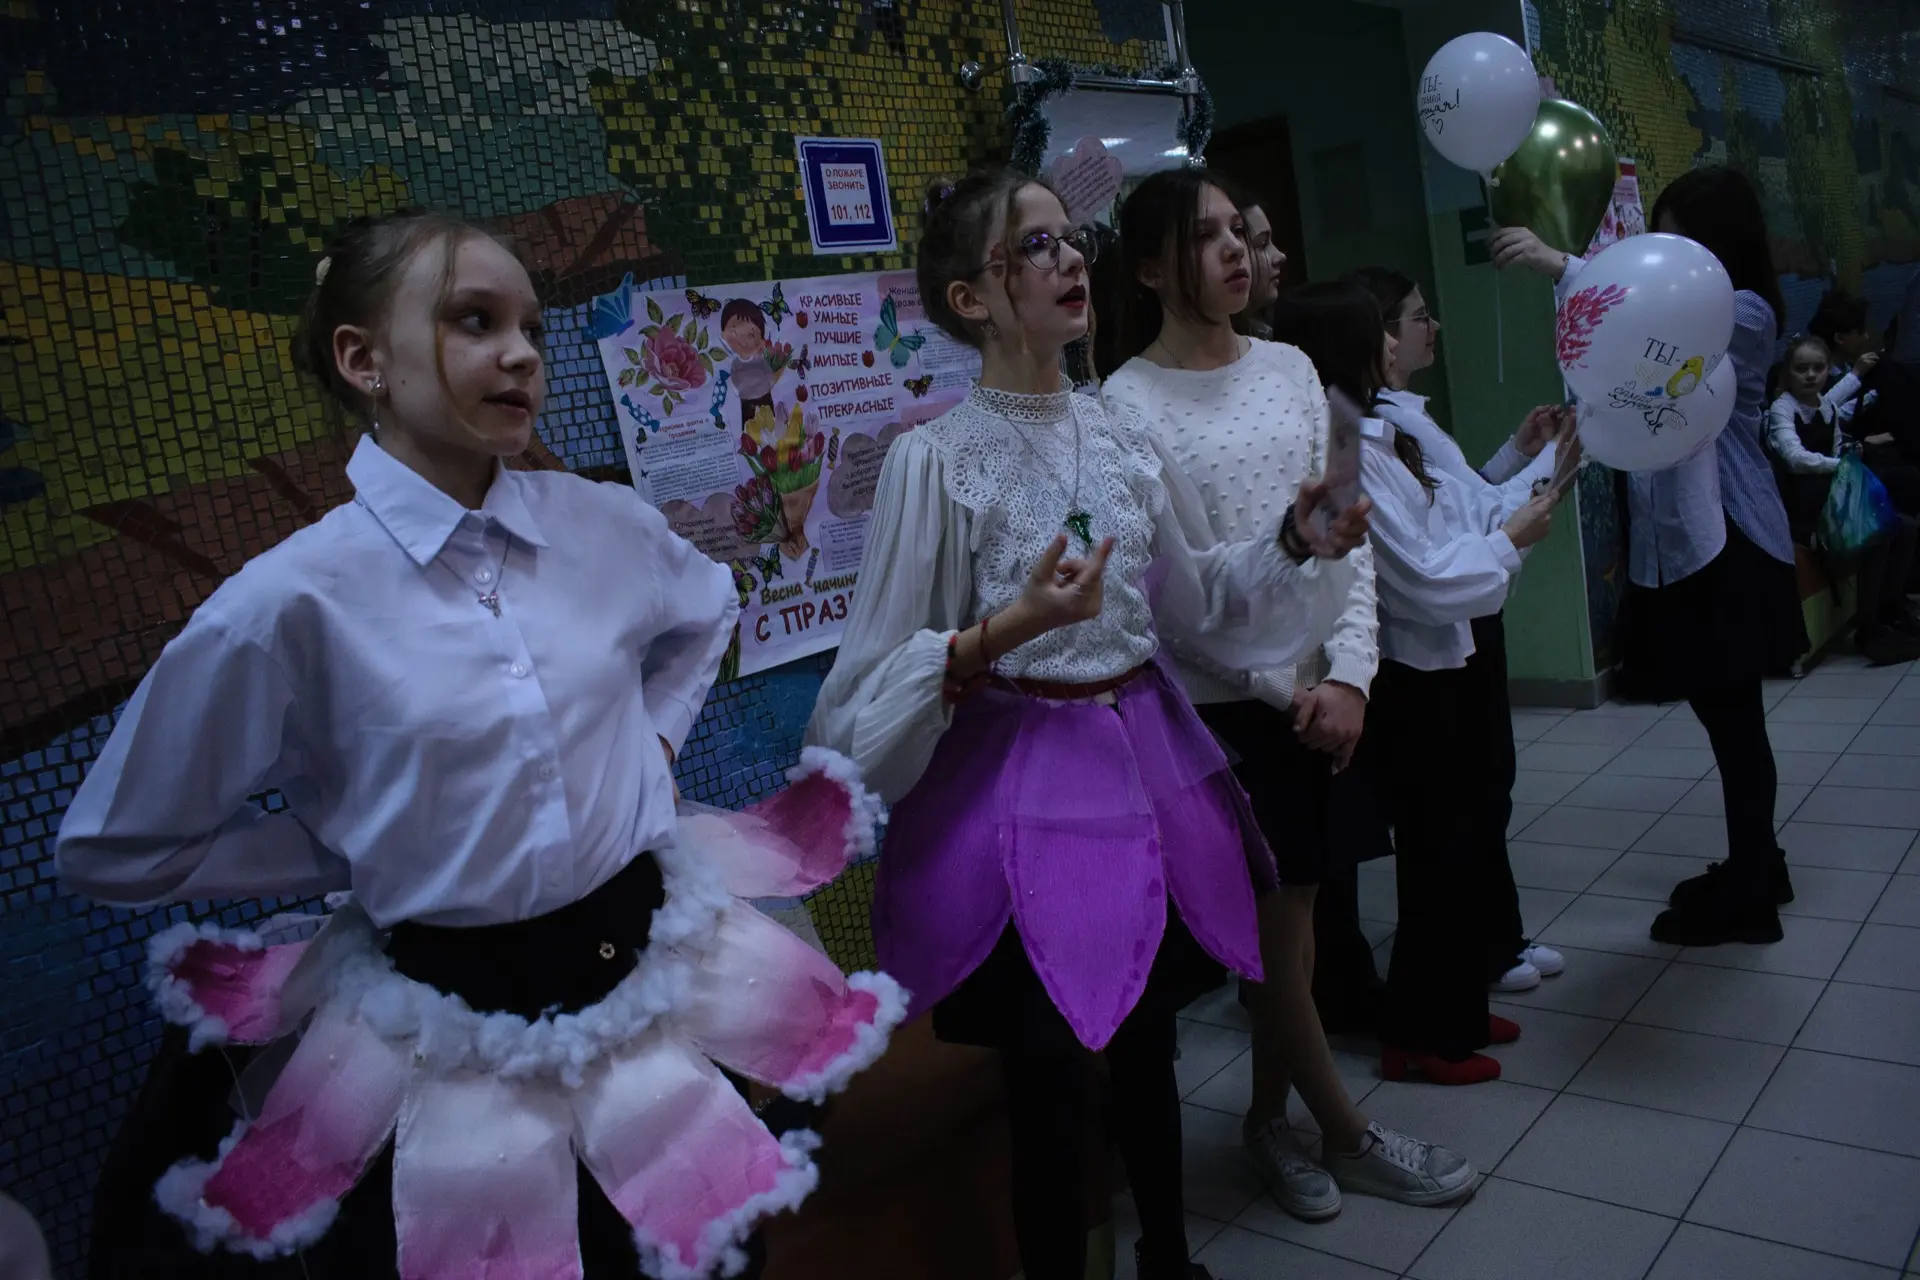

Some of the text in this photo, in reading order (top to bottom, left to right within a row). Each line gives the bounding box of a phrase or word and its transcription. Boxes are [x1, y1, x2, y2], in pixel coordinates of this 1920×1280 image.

[825, 168, 864, 178] О ПОЖАРЕ
[827, 181, 865, 190] ЗВОНИТЬ
[831, 204, 872, 221] 101, 112
[799, 292, 862, 309] КРАСИВЫЕ
[813, 310, 858, 326] УМНЫЕ
[813, 331, 862, 346] ЛУЧШИЕ
[813, 352, 858, 368] МИЛЫЕ
[810, 372, 893, 398] ПОЗИТИВНЫЕ
[817, 397, 895, 420] ПРЕКРАСНЫЕ
[761, 582, 803, 606] Весна
[755, 613, 771, 642] С
